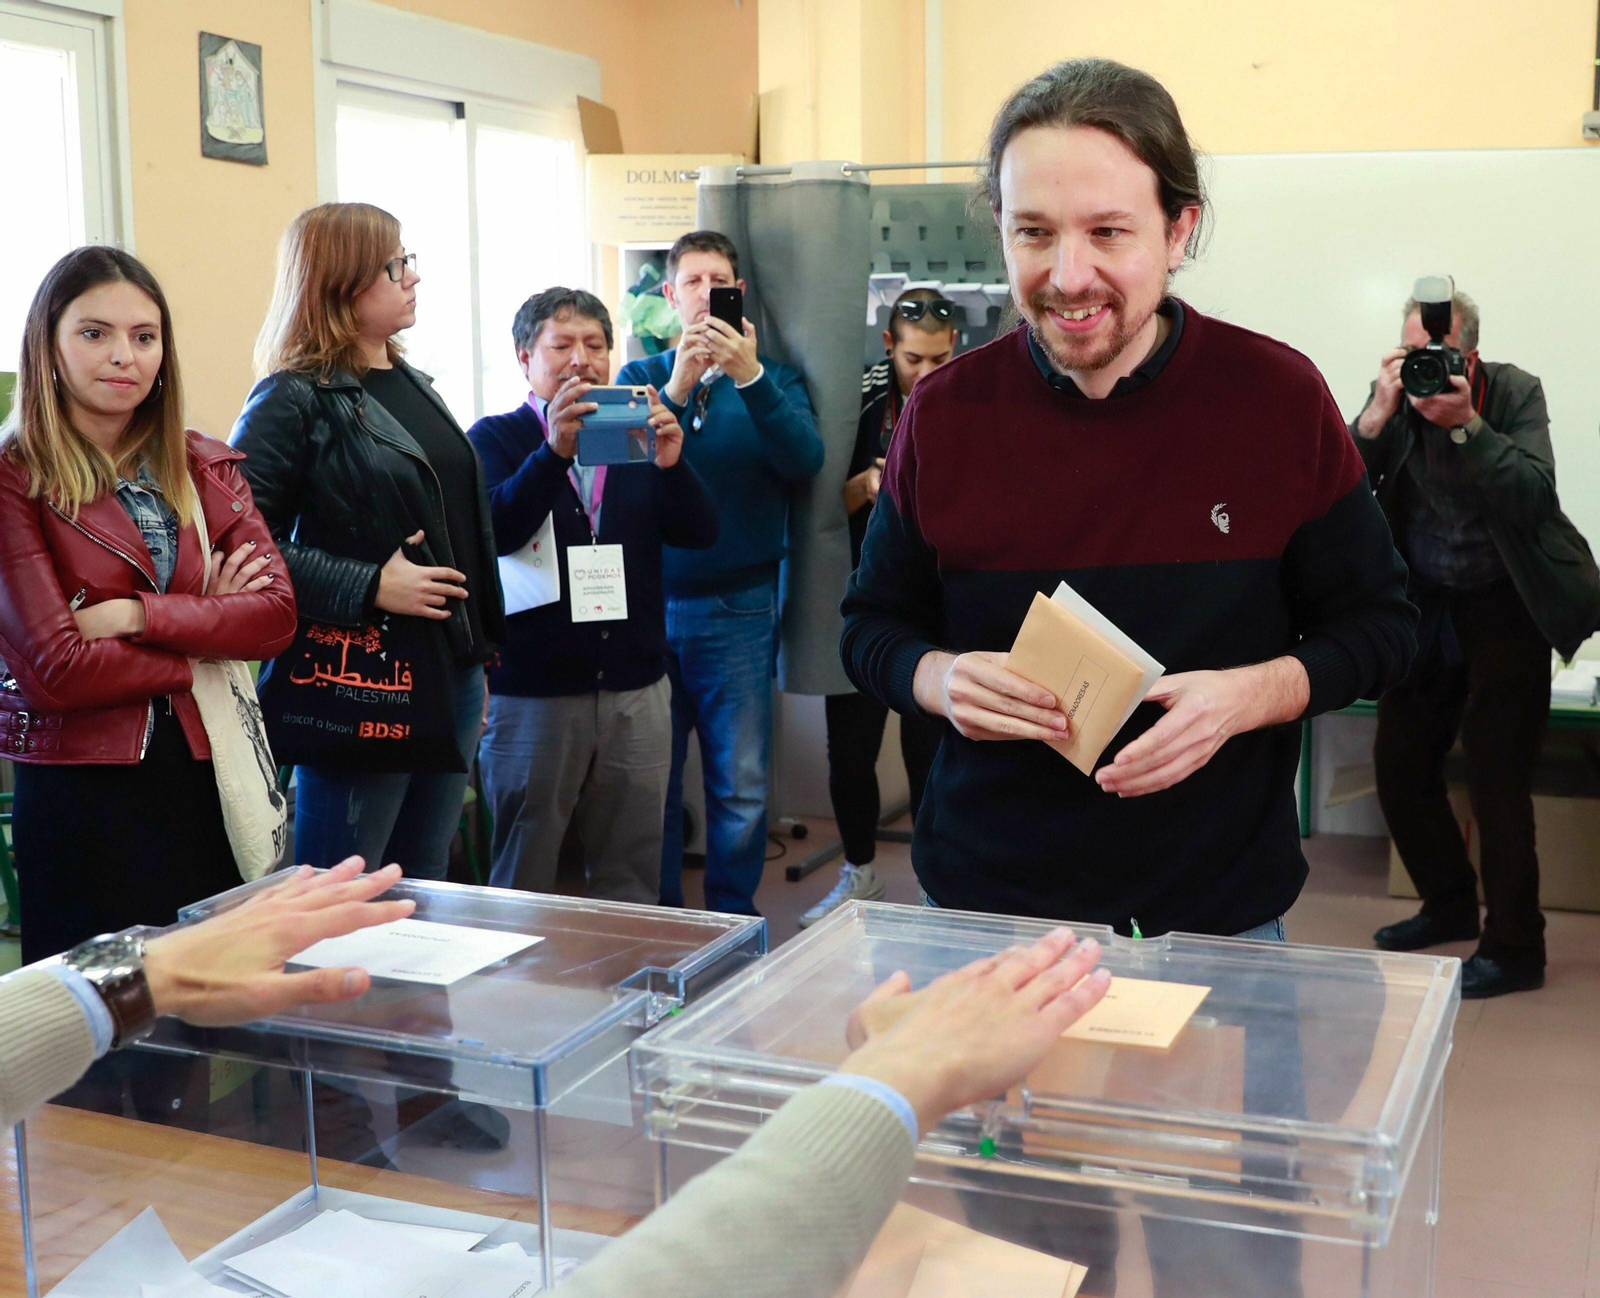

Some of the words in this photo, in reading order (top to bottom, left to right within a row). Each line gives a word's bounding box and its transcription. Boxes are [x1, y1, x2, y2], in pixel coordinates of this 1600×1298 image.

[289, 650, 413, 692] فلسطين
[335, 684, 411, 704] PALESTINA
[282, 713, 314, 726] Boicot
[316, 720, 323, 728] a
[325, 720, 354, 735] Israel
[358, 721, 411, 740] BDS!
